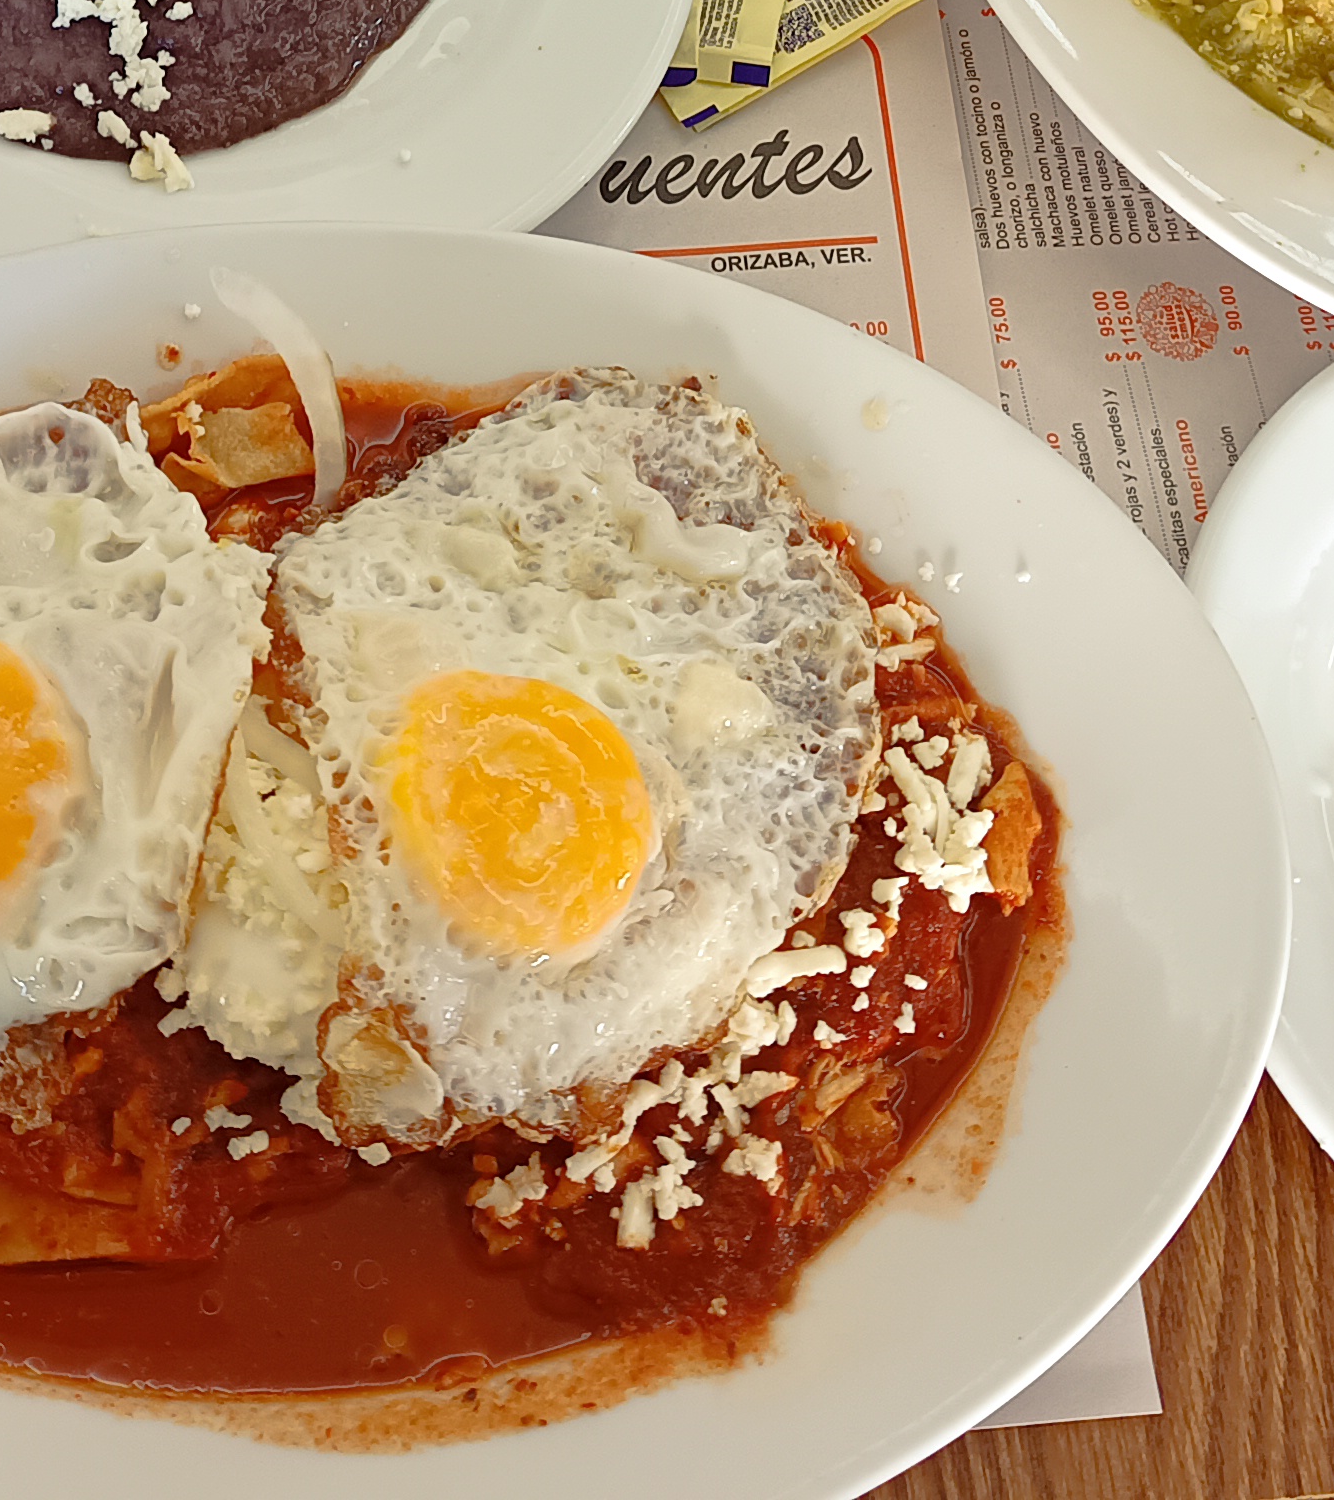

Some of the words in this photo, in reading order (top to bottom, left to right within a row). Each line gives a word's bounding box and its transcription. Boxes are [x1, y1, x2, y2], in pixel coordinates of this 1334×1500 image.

[960, 42, 981, 81] jamón
[969, 85, 979, 93] o
[971, 97, 987, 136] tocino
[1030, 113, 1046, 153] huevo
[599, 129, 873, 205] uentes
[980, 141, 993, 164] con
[1039, 158, 1052, 181] con
[1050, 122, 1073, 190] motuleños
[1071, 147, 1093, 192] natural
[985, 169, 1004, 218] huevos
[1025, 184, 1047, 247] salchicha
[996, 222, 1009, 249] Dos
[1044, 186, 1065, 247] Machaca
[1065, 195, 1085, 246] Huevos
[1083, 196, 1103, 246] Omelet
[711, 251, 815, 272] ORIZABA,
[821, 248, 871, 264] VER.
[989, 298, 1011, 344] 75.00
[1093, 292, 1115, 336] 95.00
[1113, 291, 1136, 345] 115.00
[1219, 286, 1242, 330] 90.00
[1000, 360, 1017, 369] $
[1105, 352, 1121, 362] $
[1125, 352, 1142, 360] $
[1233, 346, 1249, 355] $
[1151, 428, 1178, 506] especiales
[1176, 420, 1208, 523] Americano
